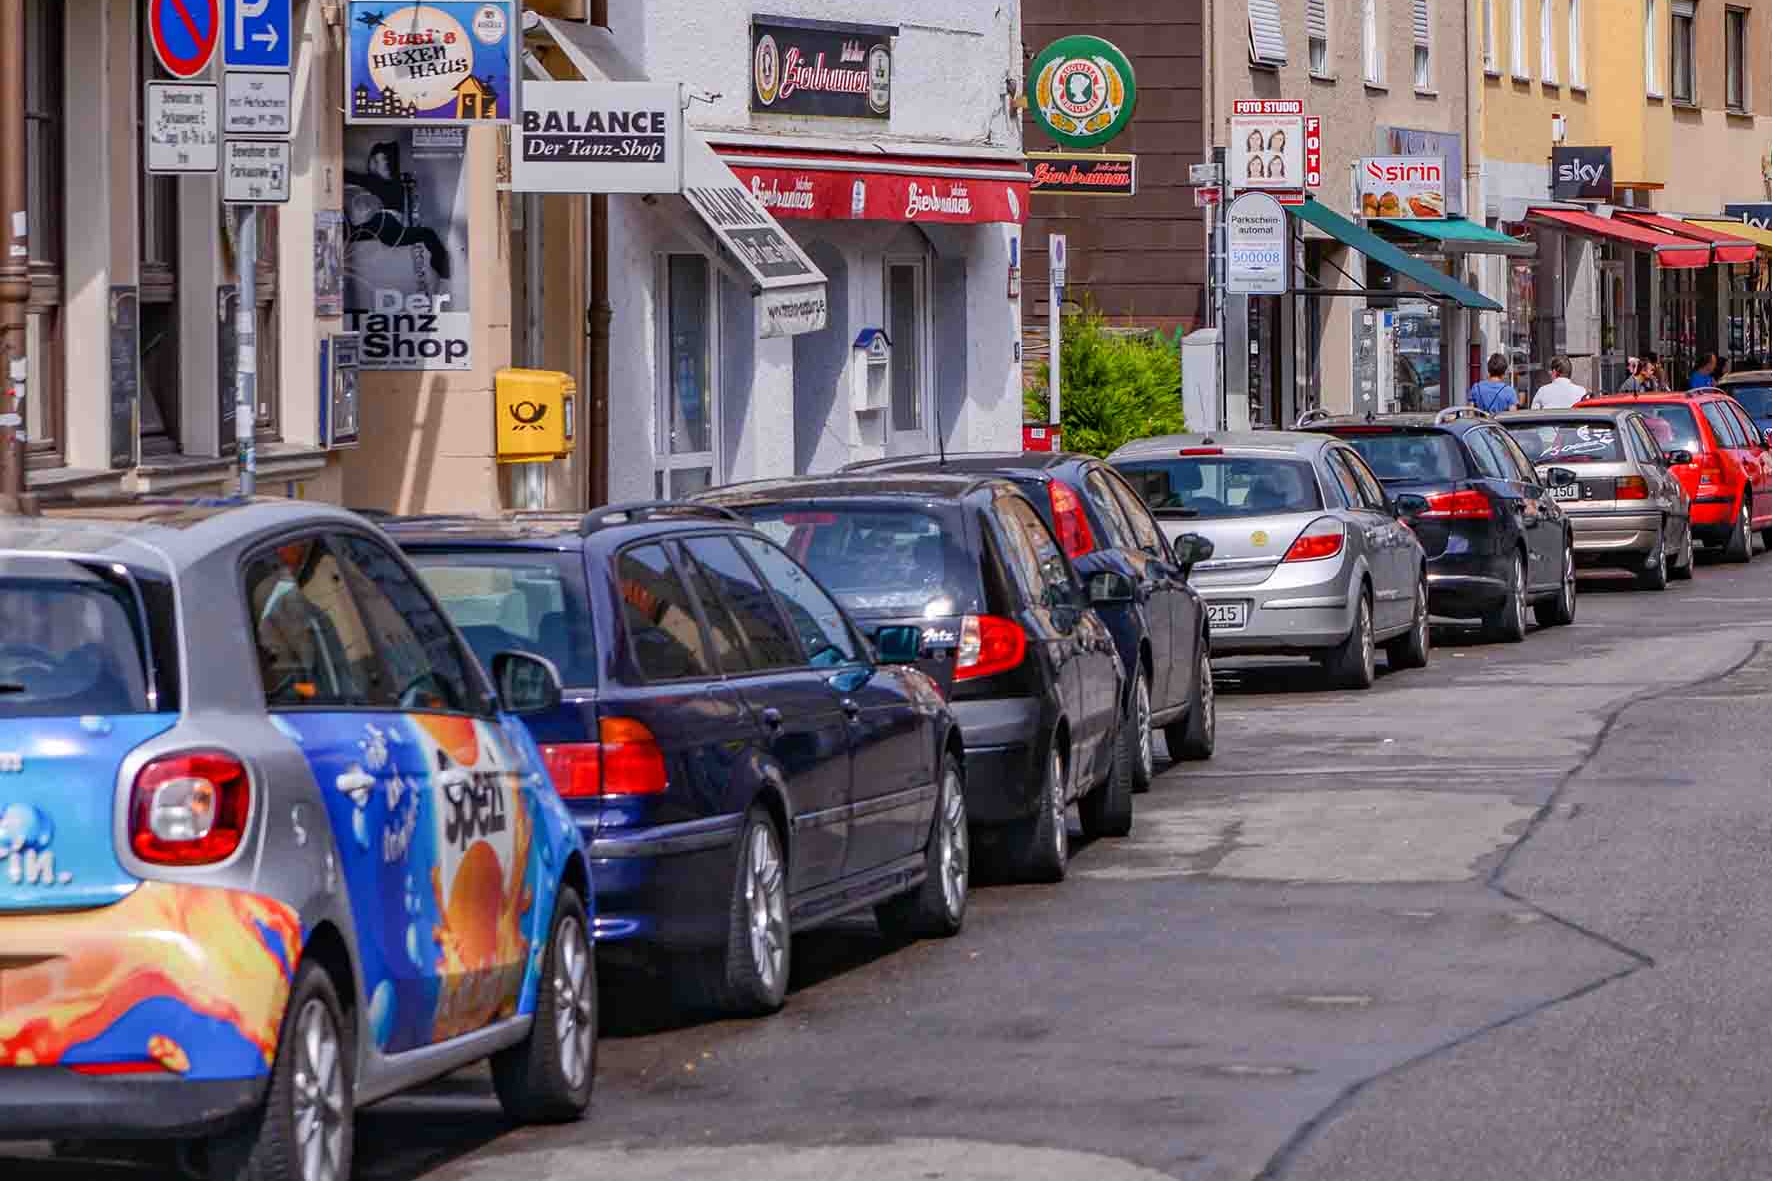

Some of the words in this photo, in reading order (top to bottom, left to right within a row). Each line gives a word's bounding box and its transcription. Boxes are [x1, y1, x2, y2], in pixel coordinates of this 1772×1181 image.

[372, 45, 448, 69] HEXEN
[407, 58, 469, 80] HAUS
[1060, 62, 1099, 80] AUGUSTA
[1237, 102, 1262, 113] FOTO
[1263, 102, 1300, 113] STUDIO
[522, 110, 665, 133] BALANCE
[528, 139, 563, 156] Der
[568, 139, 662, 161] Tanz-Shop
[1307, 119, 1320, 185] FOTO
[1386, 162, 1440, 181] sirin
[1559, 158, 1605, 187] sky
[1231, 215, 1281, 224] Parkschein-
[1239, 226, 1274, 235] automat
[375, 289, 451, 313] Der
[343, 309, 439, 333] Tanz
[362, 333, 469, 363] Shop
